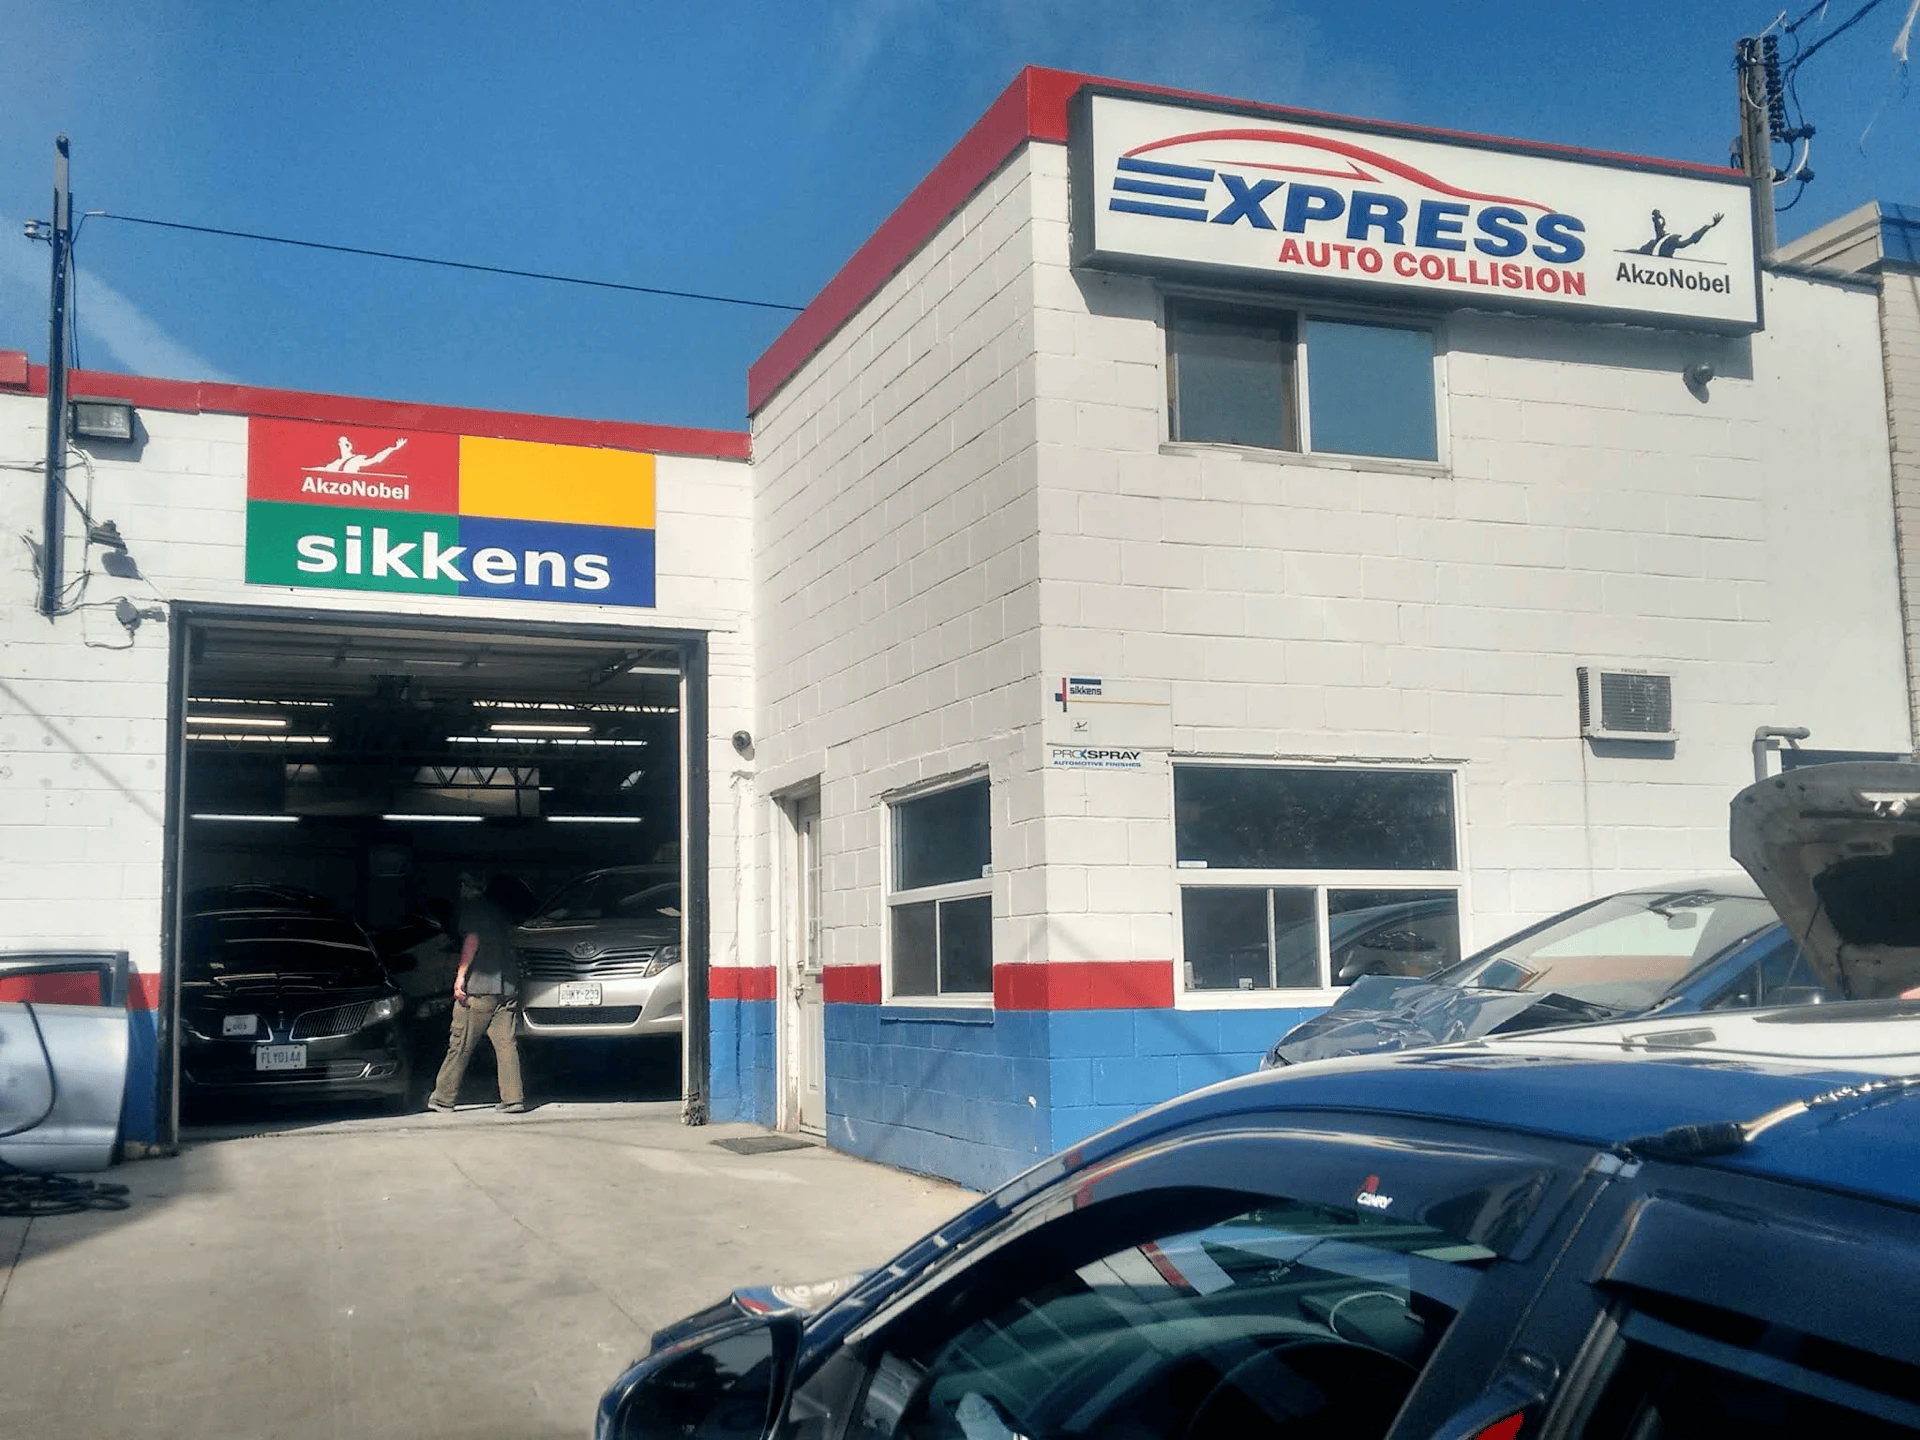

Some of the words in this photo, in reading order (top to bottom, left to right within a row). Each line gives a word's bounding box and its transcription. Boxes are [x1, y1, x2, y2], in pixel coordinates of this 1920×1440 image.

[1109, 156, 1587, 265] EXPRESS
[1278, 237, 1384, 273] AUTO
[1393, 251, 1587, 297] COLLISION
[1615, 261, 1731, 295] AkzoNobel
[301, 476, 410, 500] AkzoNobel
[296, 525, 611, 591] sikkens
[1069, 685, 1102, 696] sikkens
